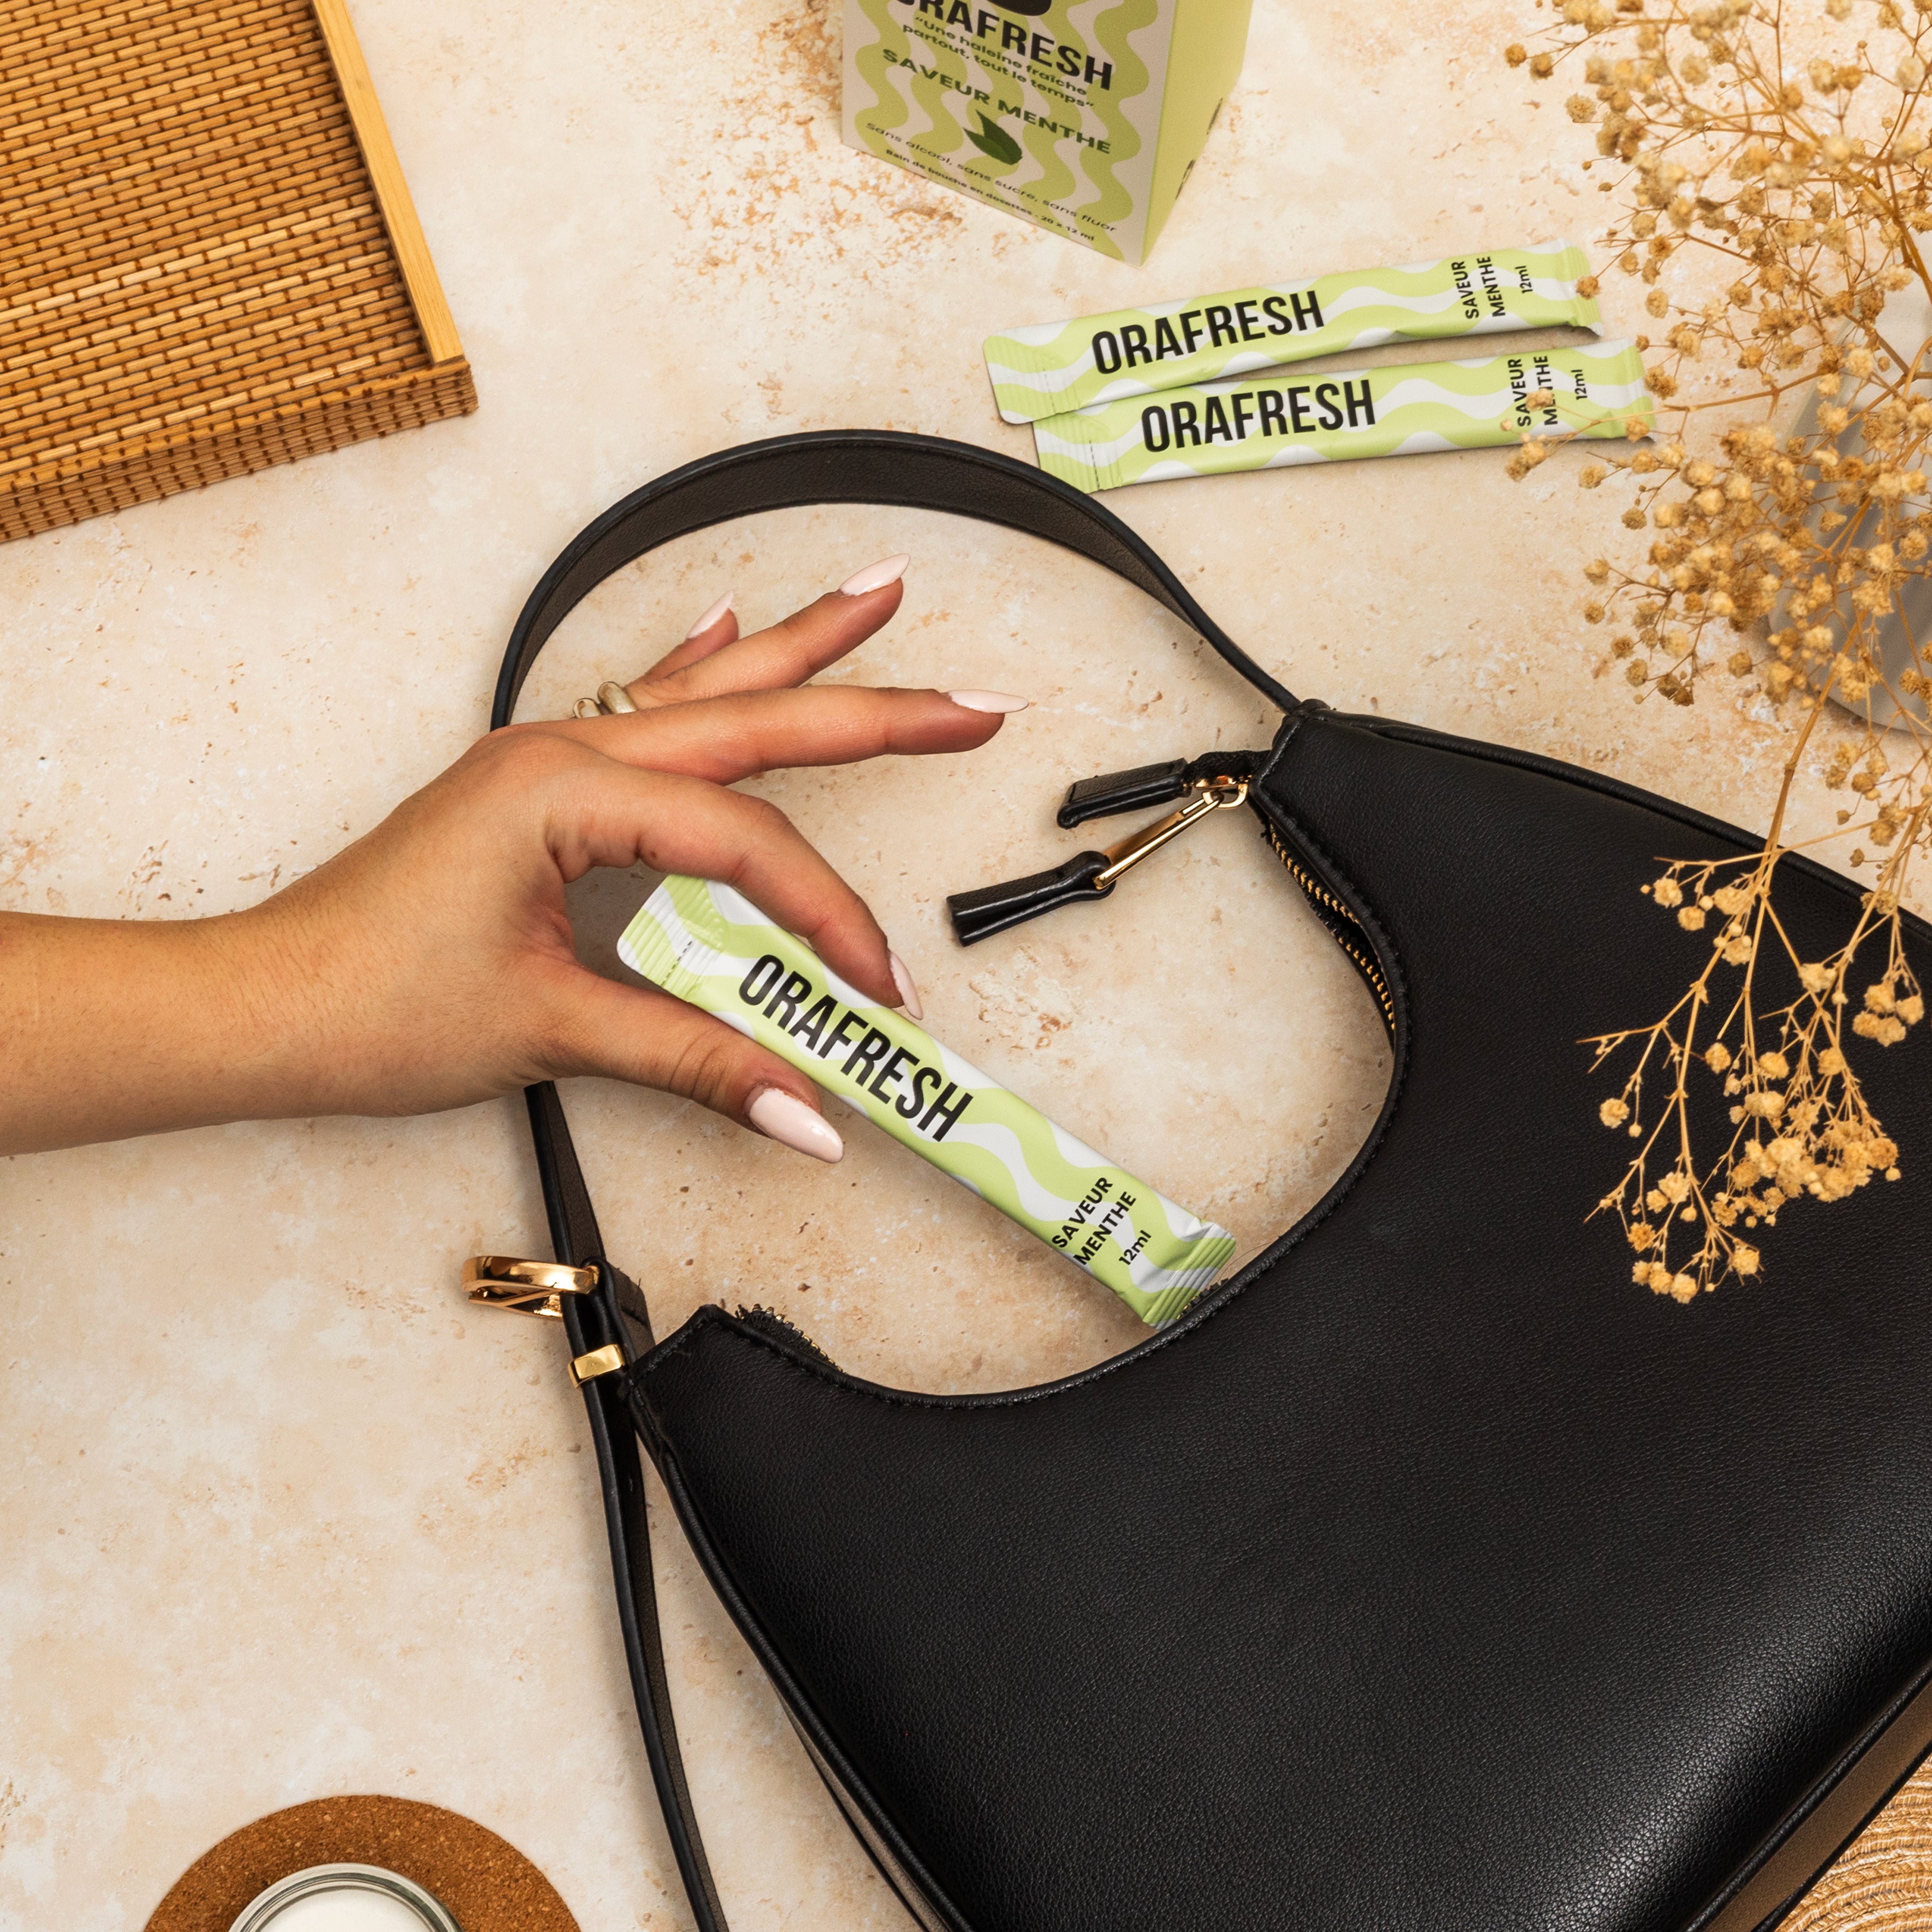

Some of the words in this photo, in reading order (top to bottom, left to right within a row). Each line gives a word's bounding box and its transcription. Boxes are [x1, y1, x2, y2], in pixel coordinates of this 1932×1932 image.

[897, 0, 1112, 91] RAFRESH
[902, 24, 970, 59] partout,
[974, 54, 1008, 75] tout
[1012, 71, 1027, 83] le
[960, 36, 1023, 68] haleine
[1026, 65, 1087, 95] fraîche
[882, 49, 990, 105] SAVEUR
[998, 99, 1111, 154] MENTHE
[866, 122, 902, 142] Sans
[906, 141, 953, 166] alcool,
[957, 163, 992, 182] sans
[995, 180, 1037, 202] sucre,
[1042, 200, 1077, 217] sans
[1081, 214, 1117, 231] fluor
[885, 149, 910, 164] Bain
[913, 160, 926, 169] de
[928, 167, 968, 187] bouche
[970, 186, 983, 194] en
[986, 193, 1032, 215] dosettes
[1041, 216, 1054, 225] 20
[1066, 226, 1078, 234] 12
[1080, 231, 1095, 241] ml
[1451, 261, 1479, 319] SAVEUR
[1477, 256, 1506, 317] MENTHE
[1515, 265, 1533, 293] 12ml
[1092, 290, 1325, 375] ORAFRESH
[1140, 379, 1376, 452] ORAFRESH
[1507, 359, 1532, 427] SAVEUR
[1533, 355, 1558, 425] MTHE
[1570, 369, 1588, 400] 12ml
[738, 953, 973, 1143] ORAFRESH
[1051, 1177, 1113, 1248] SAVEUR
[1073, 1191, 1137, 1265] MENTHE
[1118, 1229, 1152, 1266] 12ml
